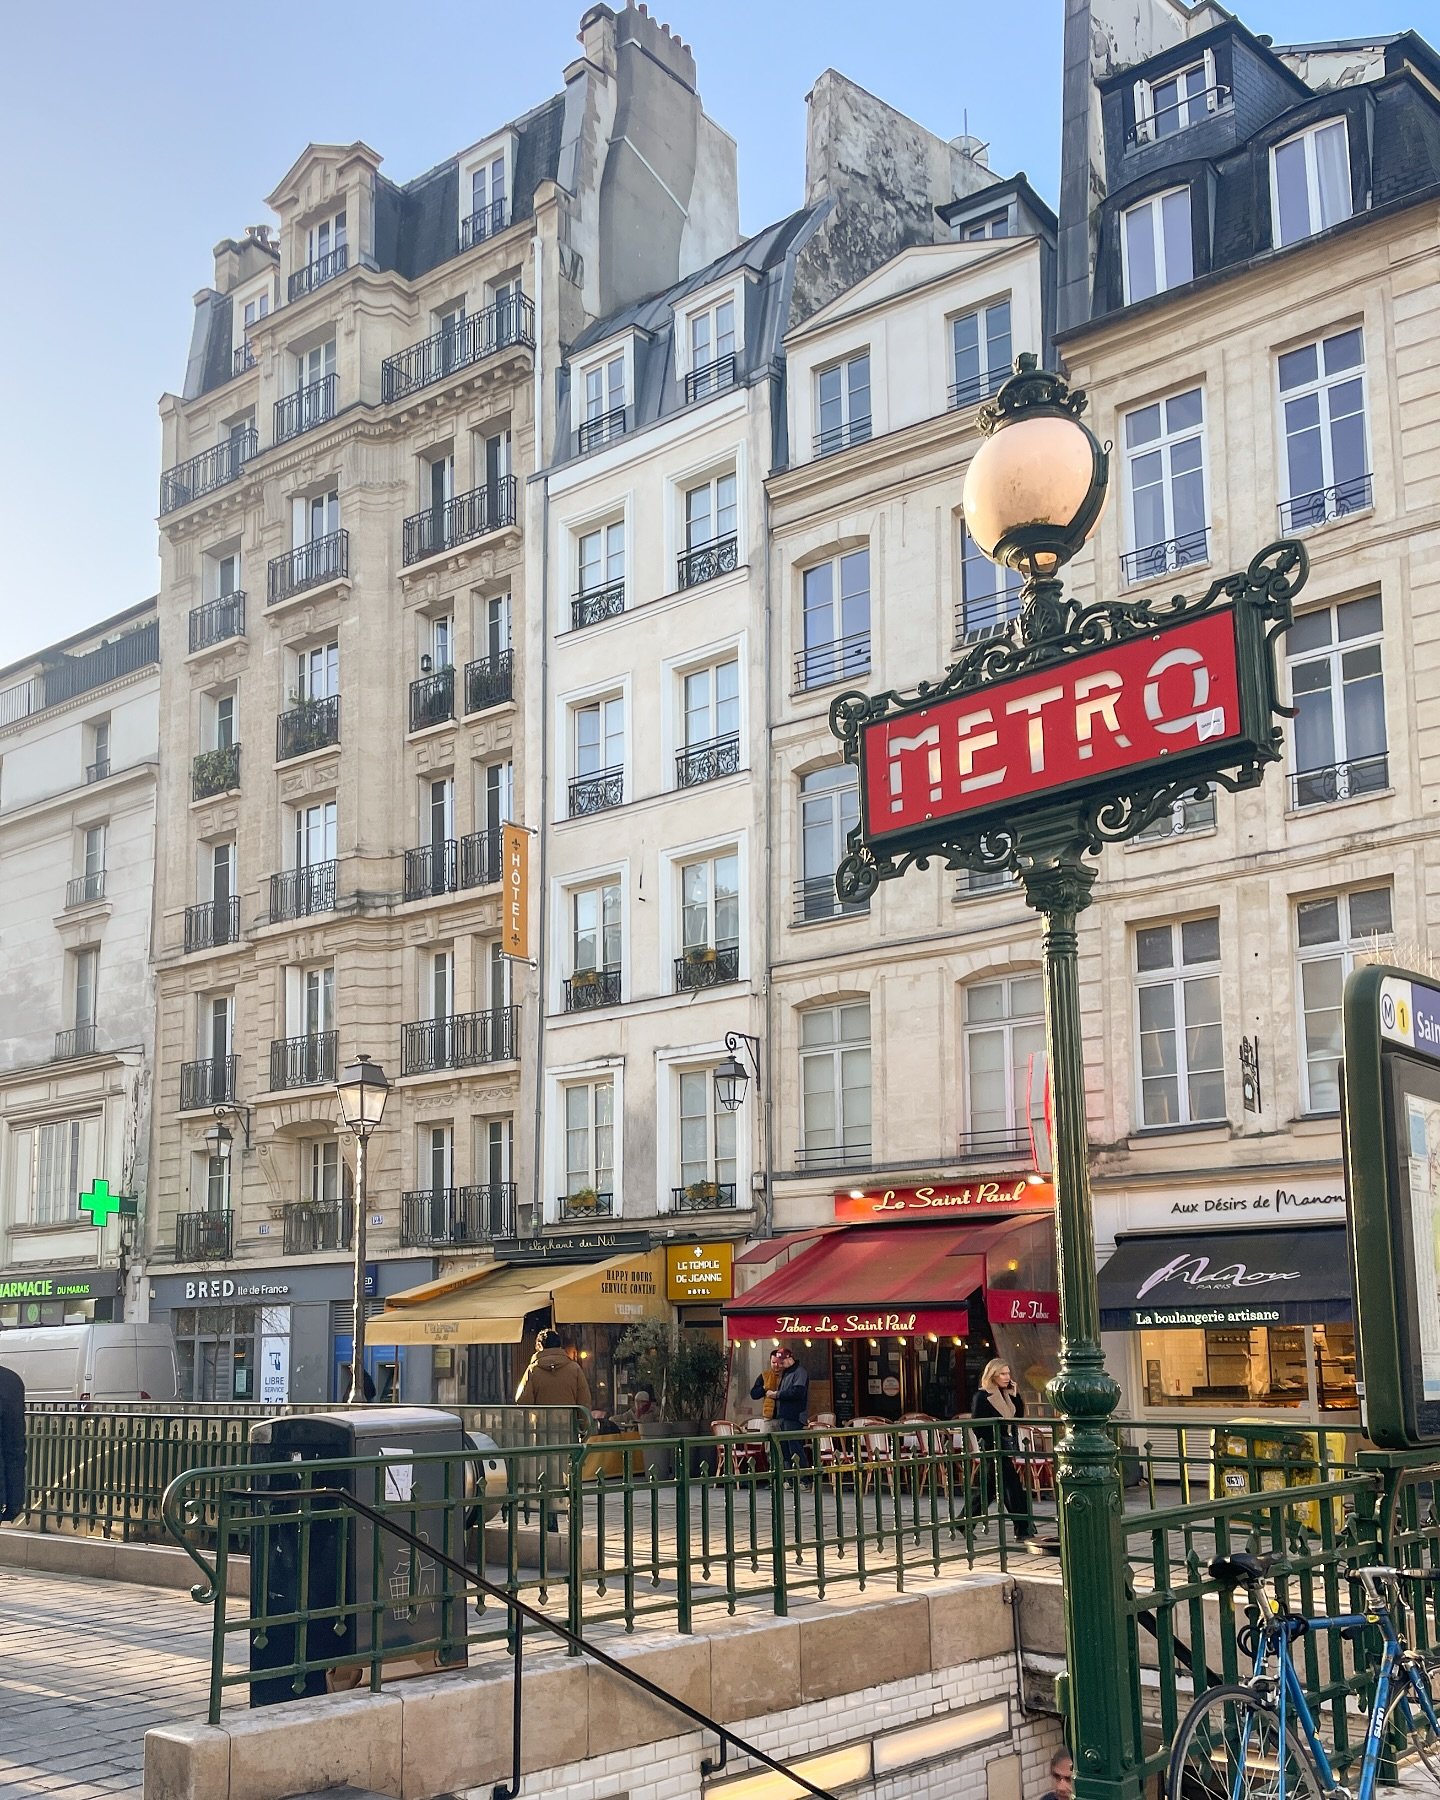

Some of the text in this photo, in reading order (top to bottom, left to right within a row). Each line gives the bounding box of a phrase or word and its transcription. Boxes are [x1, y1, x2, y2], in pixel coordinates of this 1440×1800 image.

[887, 647, 1211, 814] METRO
[511, 853, 521, 931] HÔTEL
[1400, 1006, 1407, 1028] 1
[872, 1181, 1026, 1211] Le Saint Paul
[1171, 1189, 1346, 1214] Aux Désirs de Manon
[677, 1260, 720, 1270] LE TEMPLE
[606, 1270, 653, 1282] HAPPY HOURS
[676, 1273, 722, 1283] DE JEANNE
[57, 1285, 66, 1295] DU
[67, 1284, 90, 1294] MARAIS
[185, 1279, 235, 1299] BRED
[249, 1285, 260, 1295] de
[261, 1284, 289, 1295] France
[601, 1282, 628, 1294] SERVICE
[1011, 1299, 1026, 1319] Bar
[1136, 1308, 1280, 1325] La boulangerie artisane
[774, 1314, 917, 1333] Tabac Le Saint Paul
[264, 1376, 285, 1385] LIBRE
